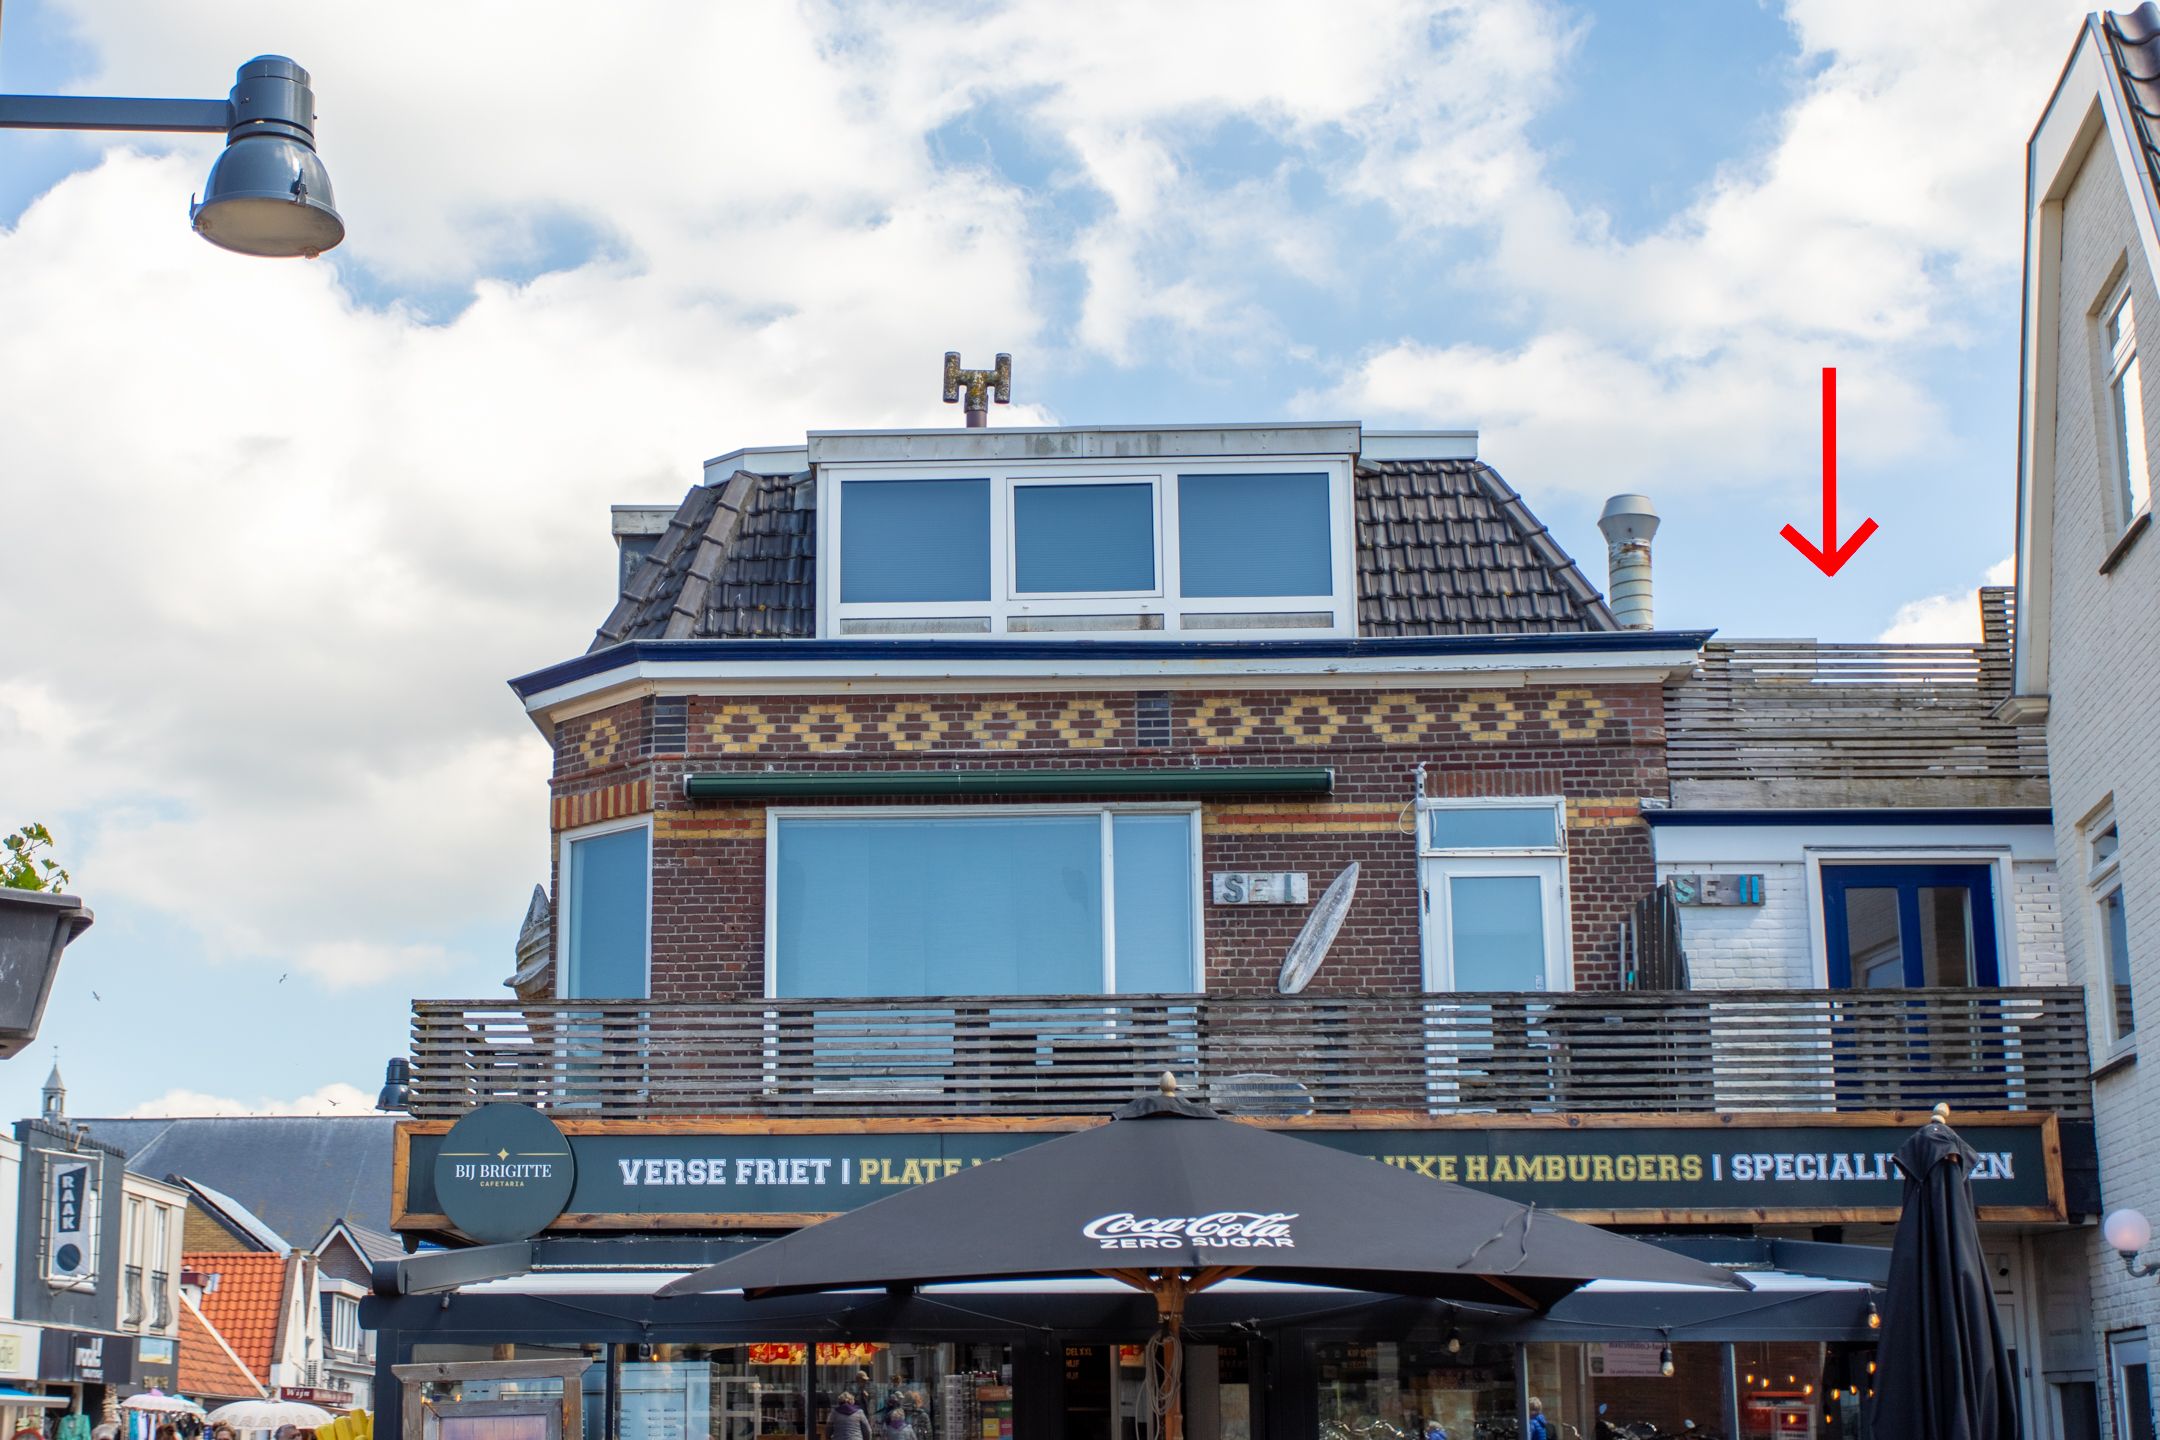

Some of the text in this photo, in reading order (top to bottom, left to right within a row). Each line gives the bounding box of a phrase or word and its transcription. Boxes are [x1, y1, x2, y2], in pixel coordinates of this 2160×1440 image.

[455, 1164, 552, 1180] BIJ BRIGITTE
[618, 1158, 727, 1186] VERSE
[735, 1158, 832, 1185] FRIET
[1464, 1154, 1703, 1182] HAMBURGERS
[61, 1175, 75, 1230] RAAK
[1083, 1212, 1300, 1240] Coca-Cola
[1100, 1237, 1296, 1249] ZERO SUGAR
